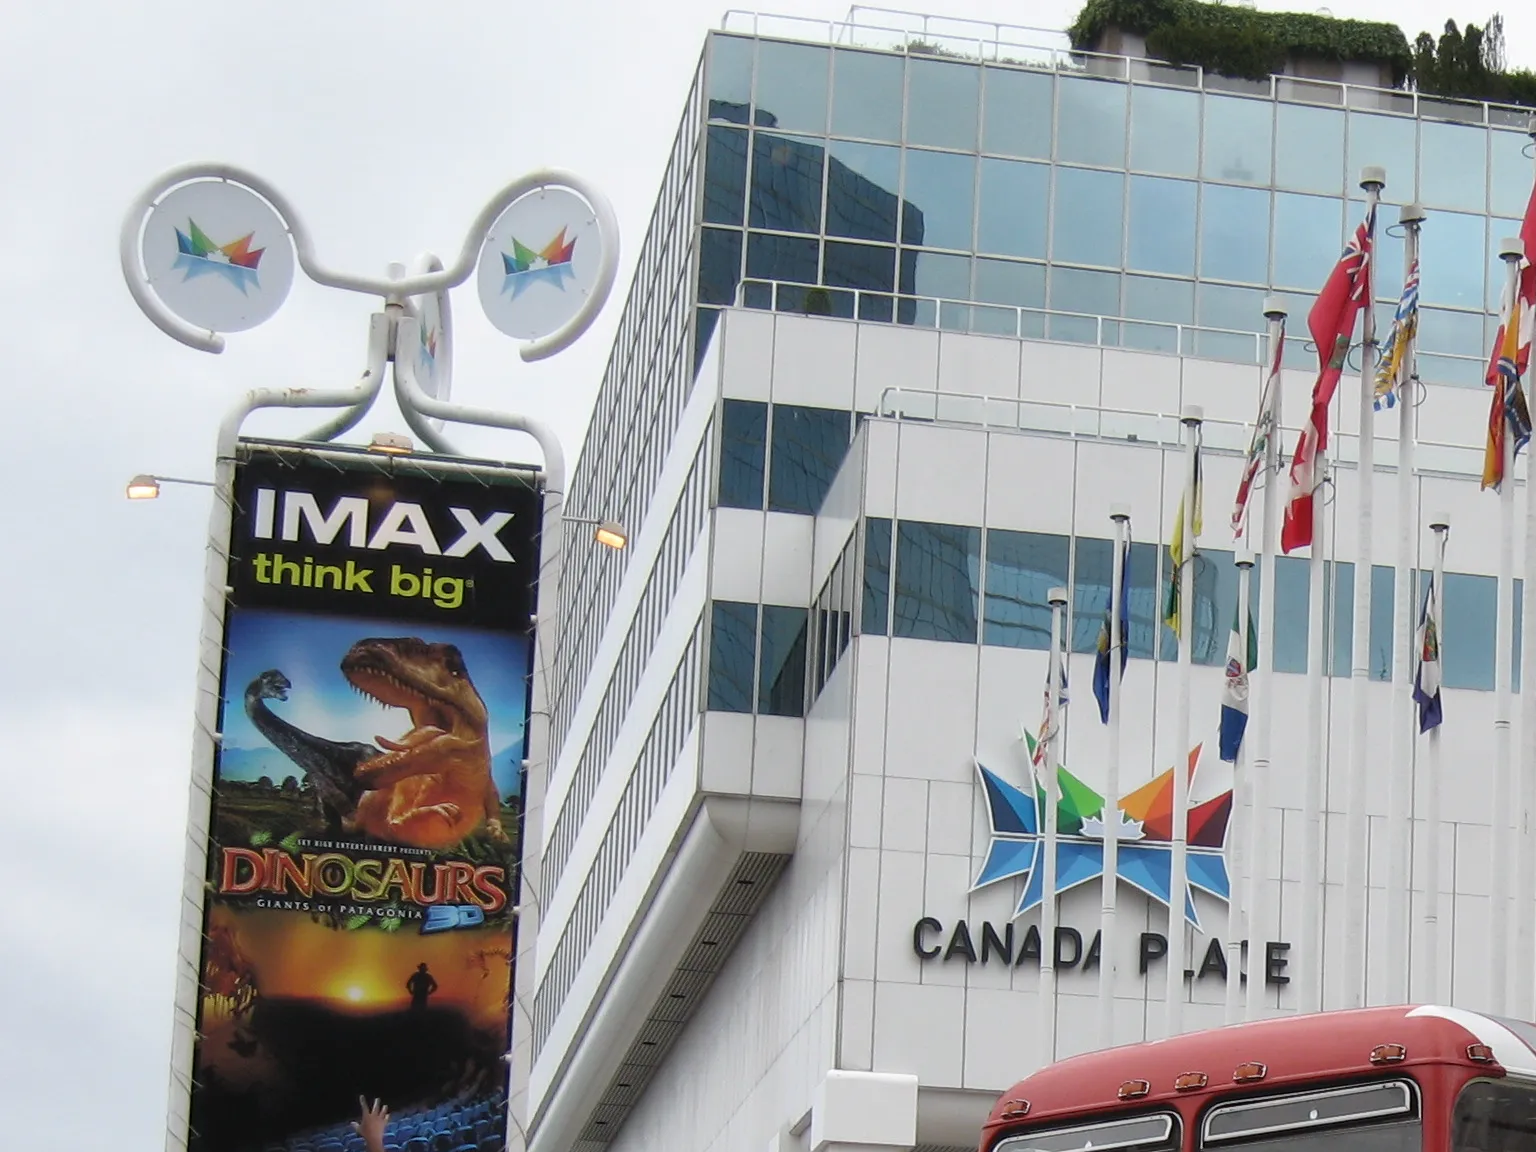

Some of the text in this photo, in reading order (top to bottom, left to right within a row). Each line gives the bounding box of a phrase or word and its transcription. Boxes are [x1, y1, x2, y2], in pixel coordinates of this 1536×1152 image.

[253, 489, 516, 564] IMAX
[253, 553, 374, 594] think
[219, 847, 507, 913] DINOSAURS
[257, 899, 310, 912] GIANTS
[340, 905, 422, 919] PATAGONIA
[420, 904, 485, 935] 3D
[1140, 931, 1291, 985] PAE
